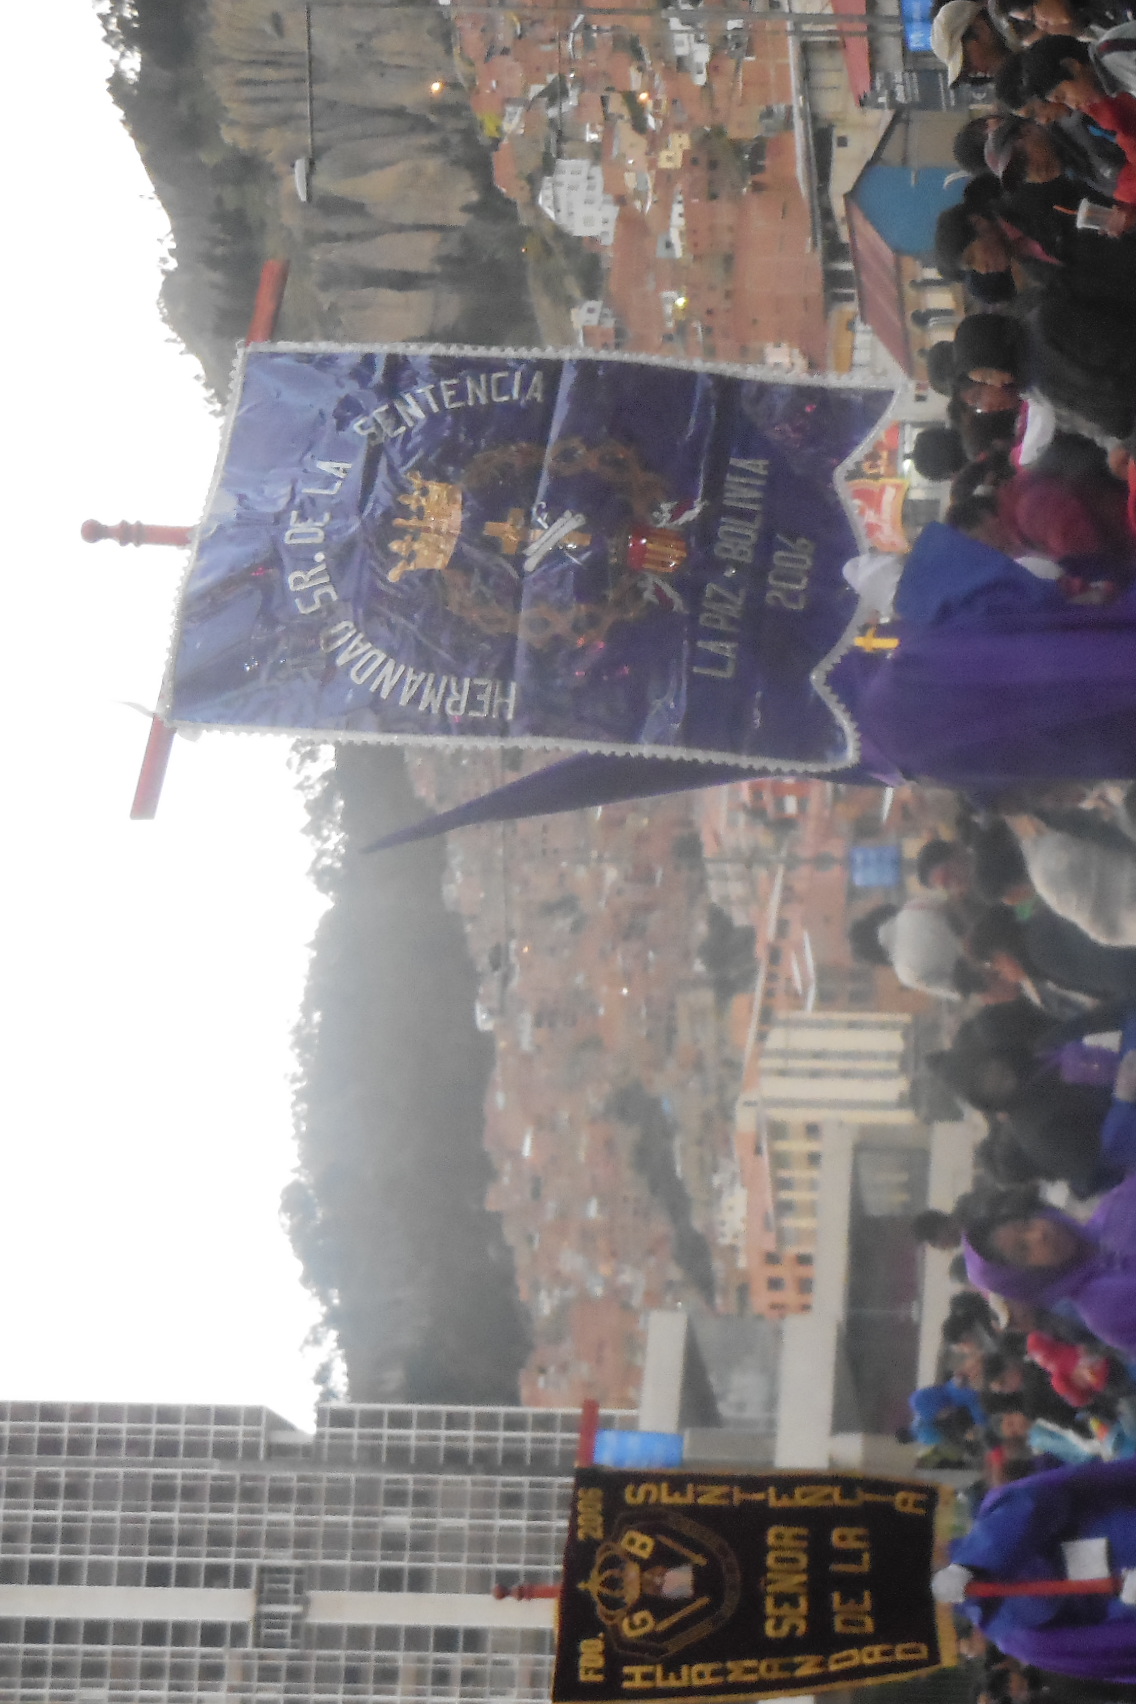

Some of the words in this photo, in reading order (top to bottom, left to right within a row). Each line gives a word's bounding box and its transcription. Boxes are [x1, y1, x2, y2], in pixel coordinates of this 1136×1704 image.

[353, 369, 545, 446] SENTENCIA
[302, 460, 352, 494] LA
[285, 509, 332, 545] DE
[714, 458, 769, 563] BOLIVIA
[288, 552, 338, 614] SR.
[766, 533, 814, 609] 2006
[700, 582, 746, 632] PAZ
[320, 620, 517, 721] HERMANDAD
[693, 640, 738, 679] LA
[625, 1481, 929, 1516] SENTENCIA
[621, 1530, 655, 1560] B
[829, 1526, 870, 1574] LA
[622, 1609, 656, 1638] G
[833, 1589, 875, 1635] DE
[622, 1641, 929, 1689] HERMANDAD
